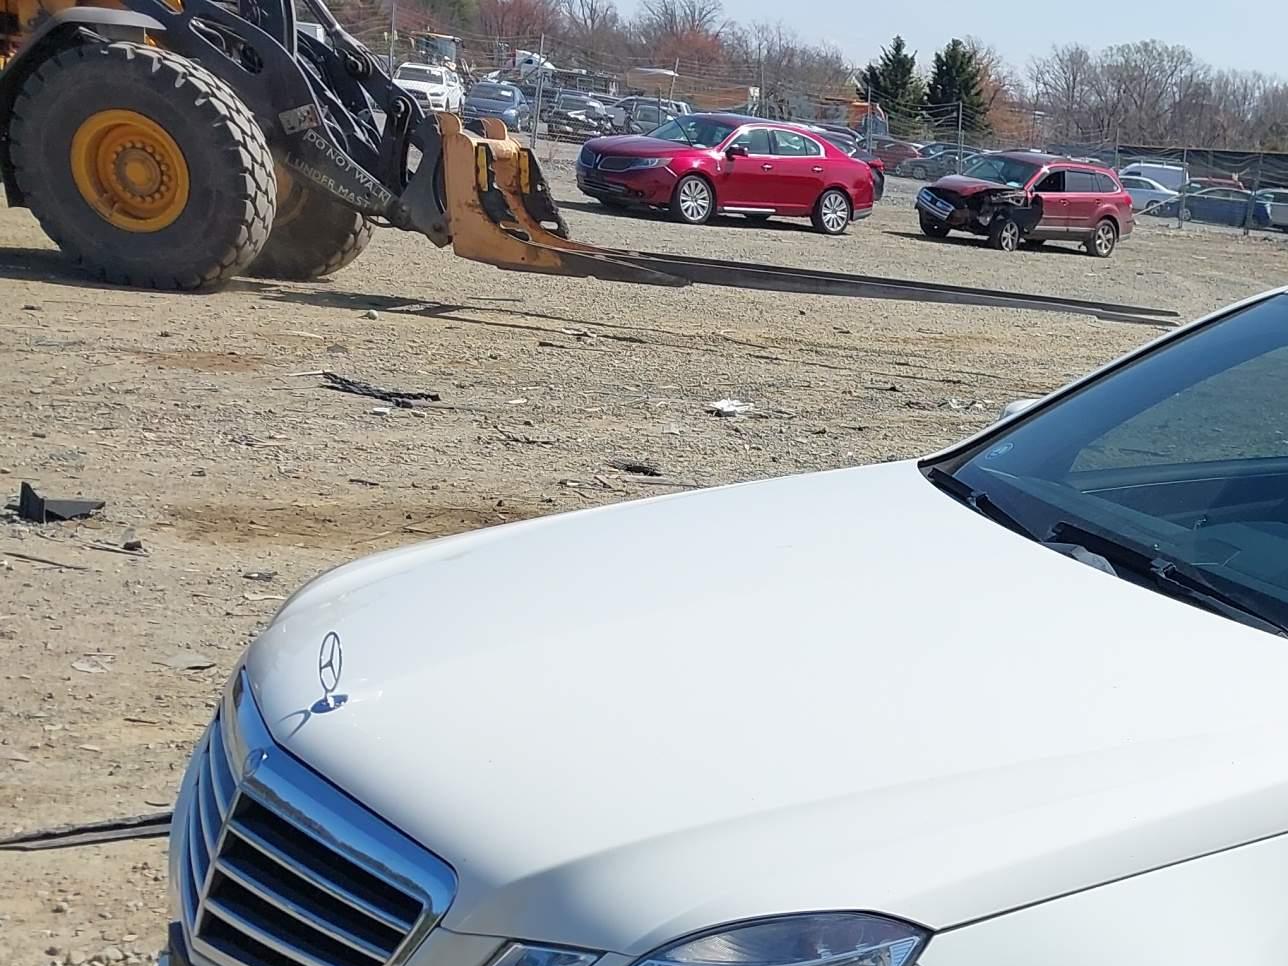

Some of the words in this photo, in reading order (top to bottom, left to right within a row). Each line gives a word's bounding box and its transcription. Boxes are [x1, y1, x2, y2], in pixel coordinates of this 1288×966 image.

[294, 158, 336, 191] UNDER
[338, 185, 371, 208] MAST
[306, 130, 326, 150] DO
[326, 148, 354, 172] NOT
[354, 168, 389, 203] WALK
